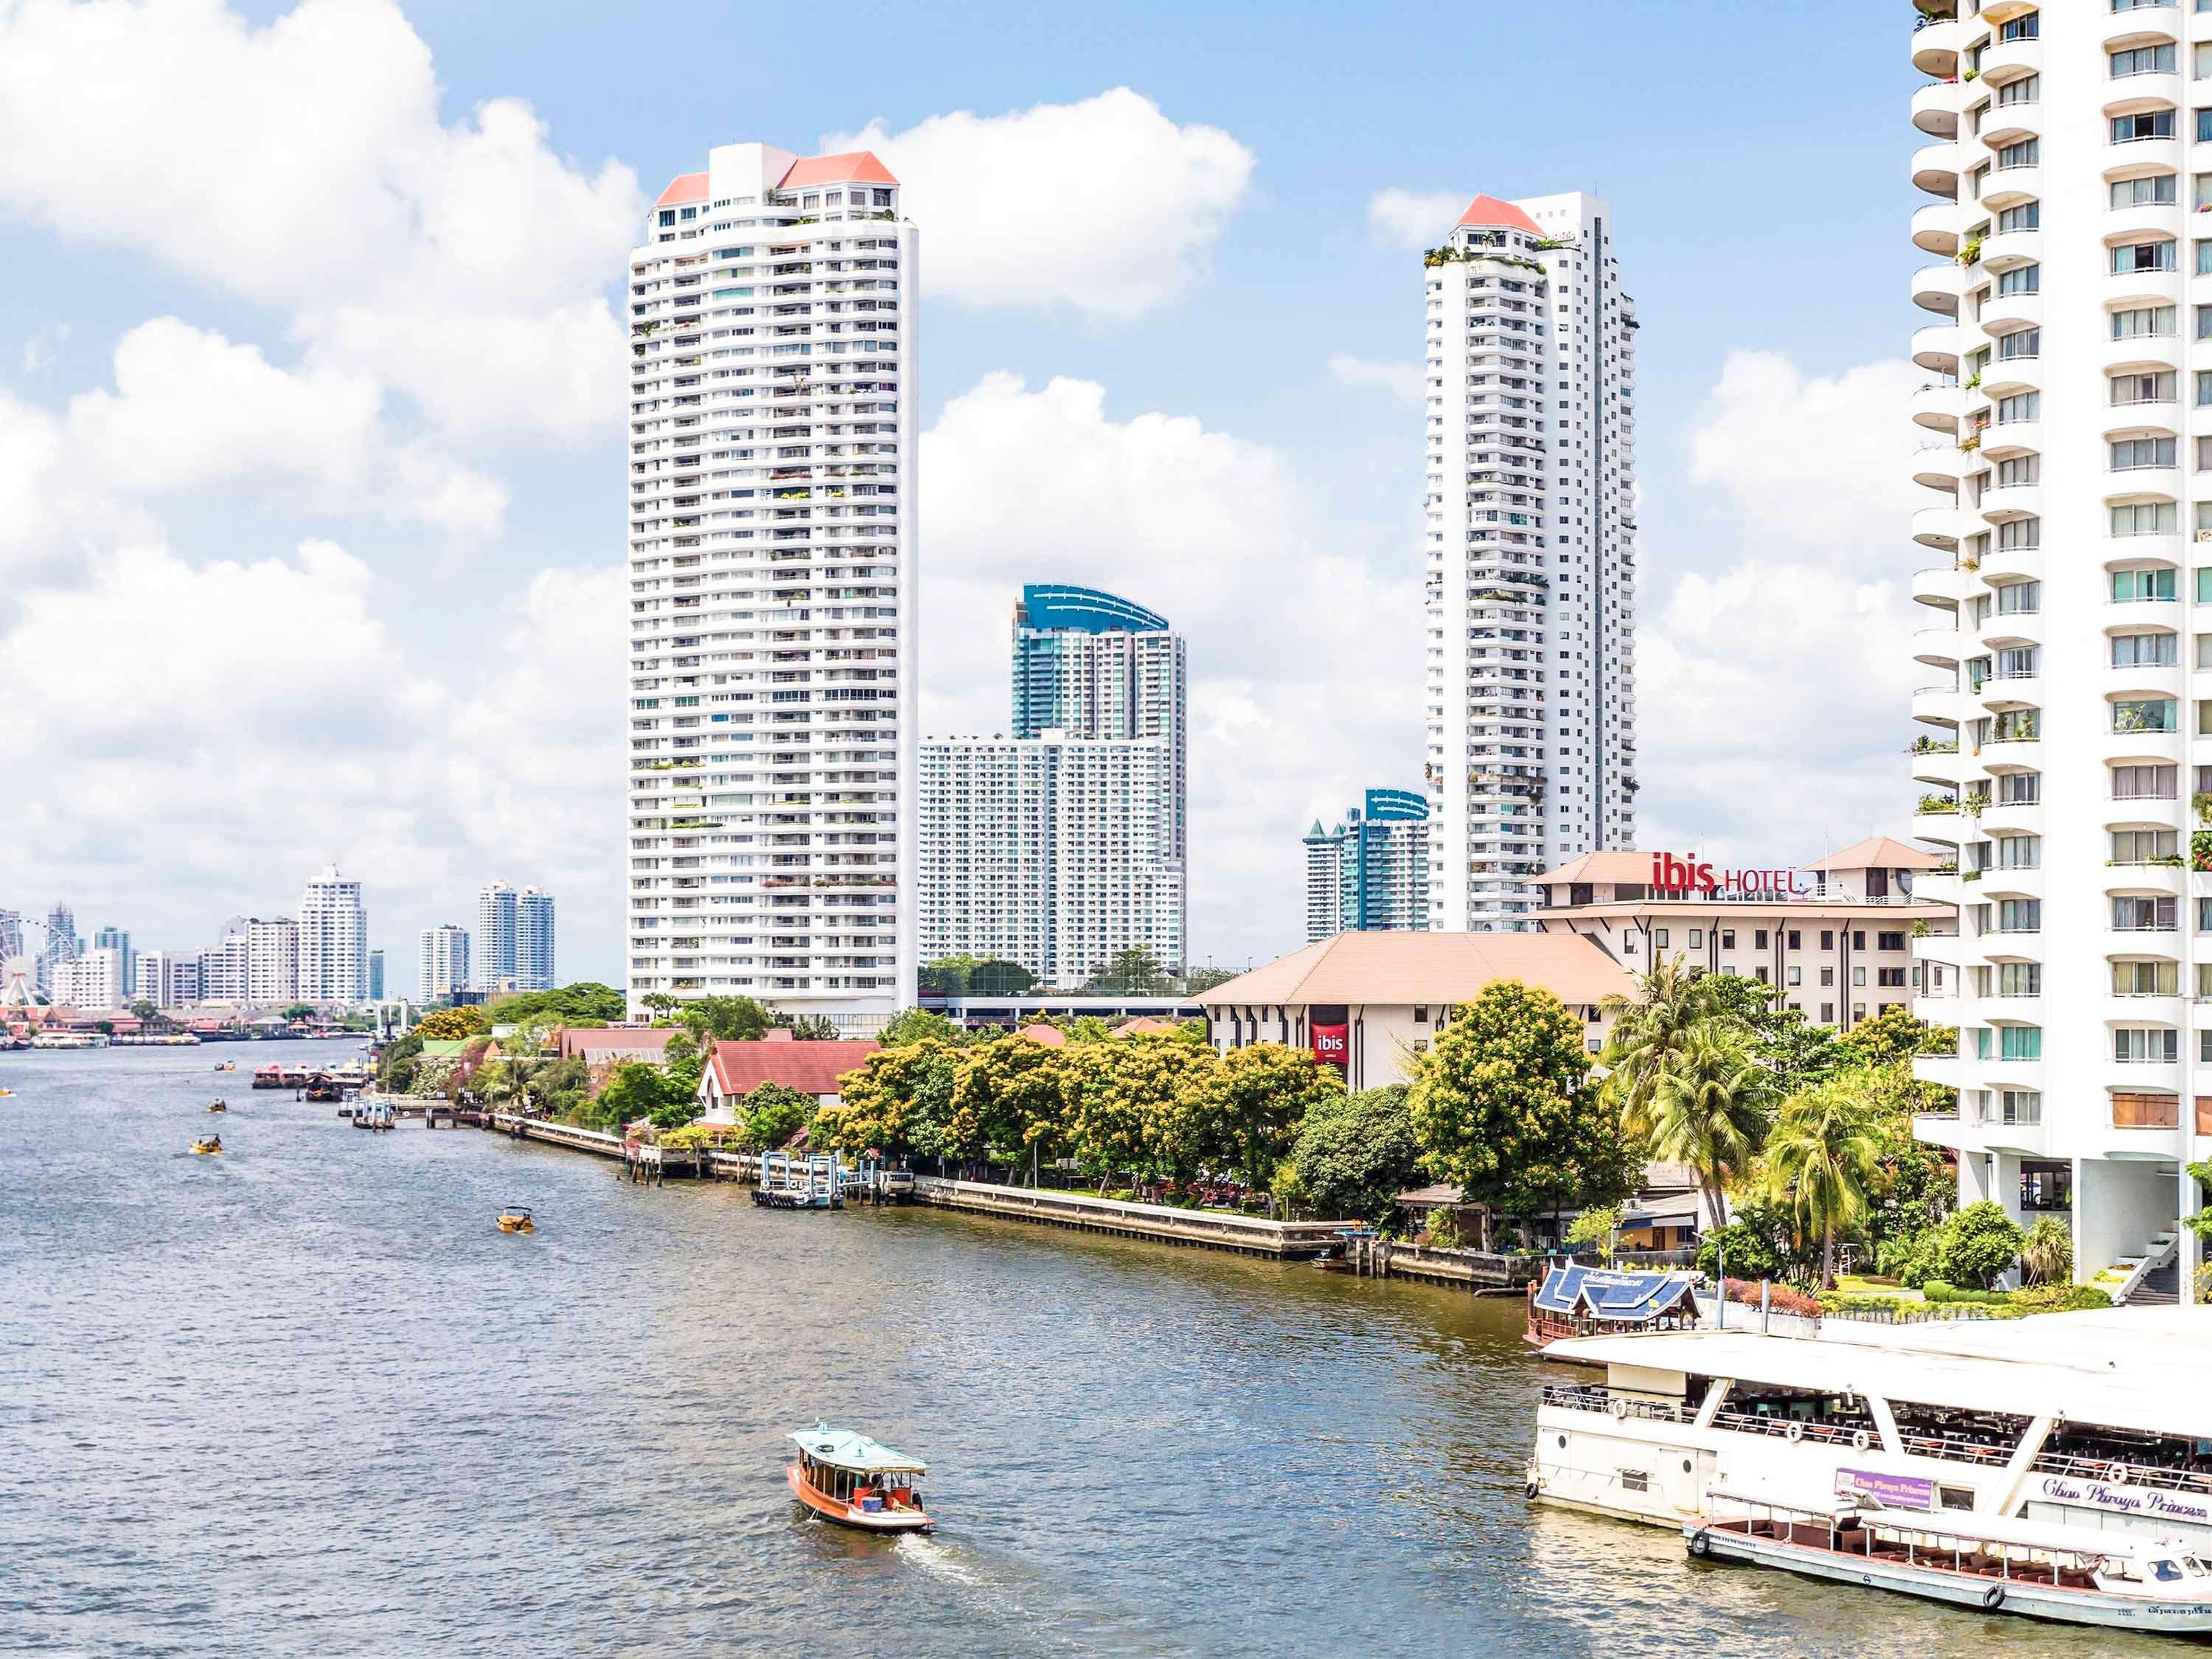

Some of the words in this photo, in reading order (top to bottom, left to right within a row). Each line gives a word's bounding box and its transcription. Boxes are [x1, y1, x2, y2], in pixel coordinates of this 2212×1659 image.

[1652, 852, 1714, 891] ibis
[1725, 869, 1800, 893] HOTEL
[1318, 1034, 1343, 1051] ibis
[2042, 1478, 2080, 1500] Chao
[2085, 1484, 2141, 1511] Phraya
